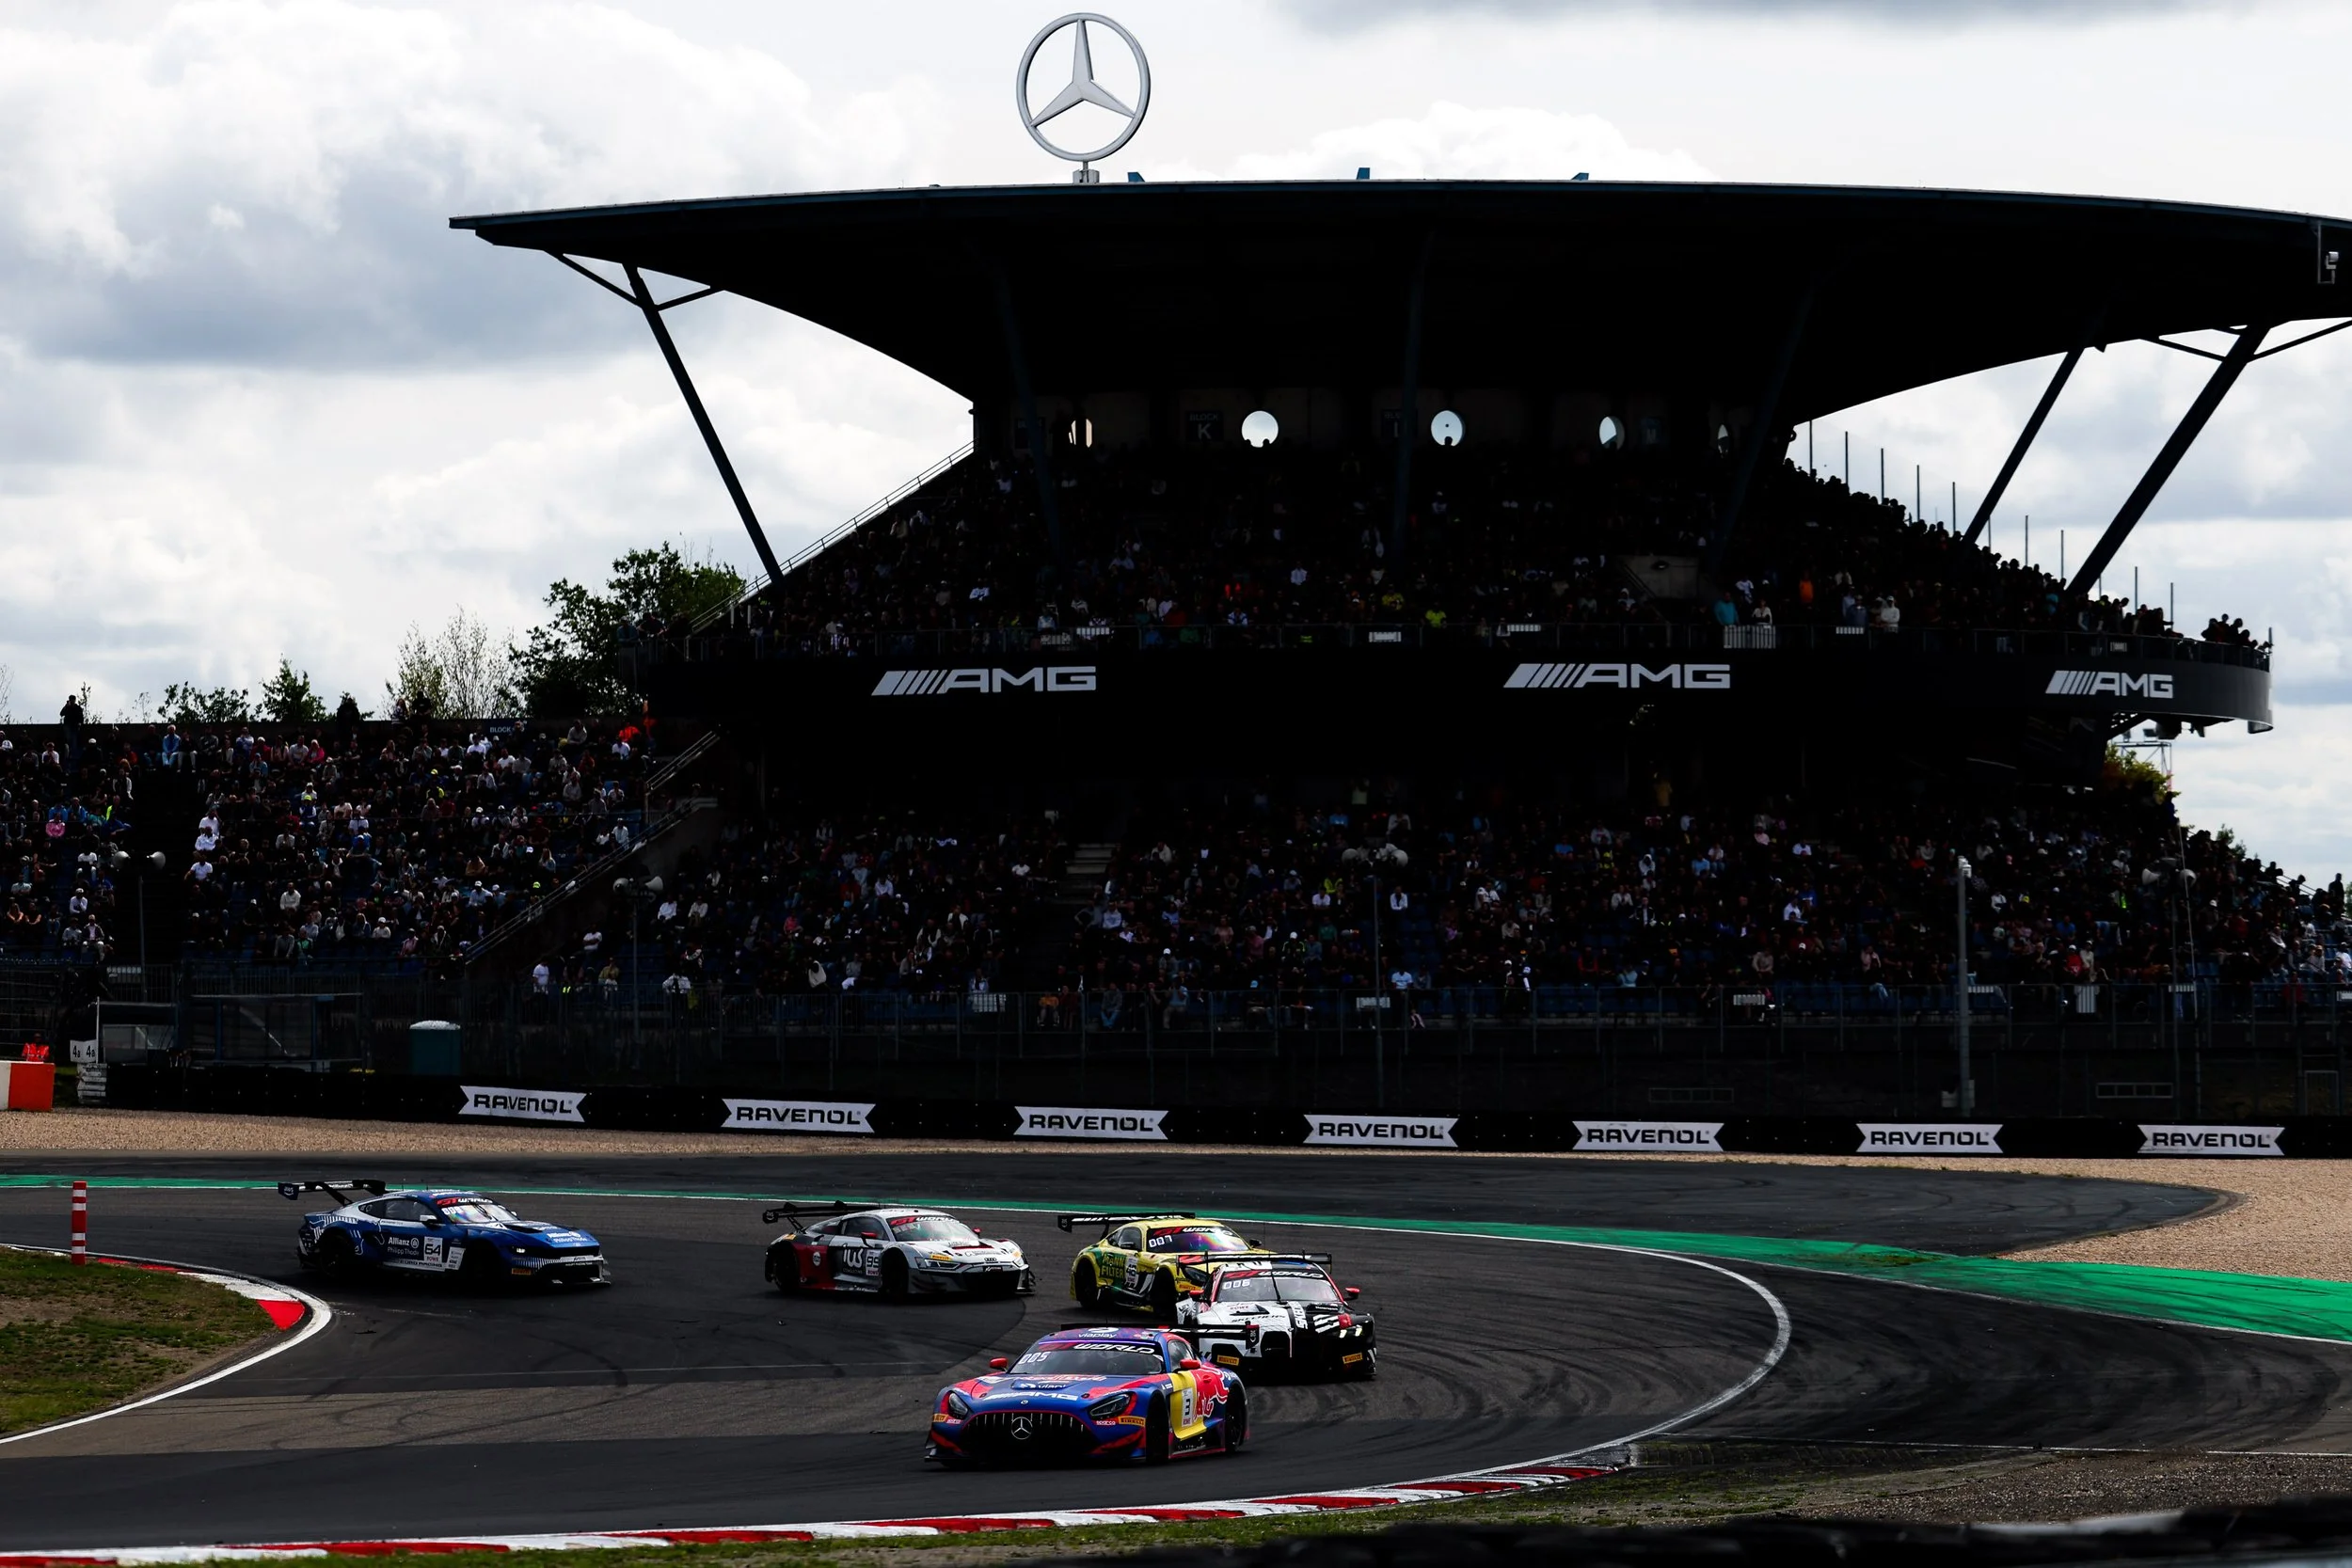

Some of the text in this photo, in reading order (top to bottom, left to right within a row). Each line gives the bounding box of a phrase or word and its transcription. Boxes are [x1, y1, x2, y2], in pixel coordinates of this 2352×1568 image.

[1197, 422, 1212, 440] K
[937, 667, 1095, 694] AMG
[1574, 664, 1729, 688] AMG
[2090, 672, 2172, 698] AMG
[72, 1044, 96, 1058] 4a 4a
[474, 1095, 571, 1114] RAVENOL
[737, 1107, 860, 1124] RAVENOL
[1029, 1115, 1152, 1132] RAVENOL
[1319, 1123, 1443, 1139] RAVENOL
[1587, 1129, 1708, 1144] RAVENOL
[1871, 1132, 1989, 1145] RAVENOL
[2153, 1132, 2270, 1148] RAVENOL
[387, 1237, 410, 1246] Allianz
[1149, 1234, 1172, 1248] 007
[425, 1243, 441, 1256] 64
[1103, 1253, 1124, 1269] MANN
[1101, 1265, 1123, 1279] FILTER
[1073, 1343, 1155, 1354] WORLD
[1017, 1351, 1052, 1364] 005
[1184, 1399, 1191, 1416] 3
